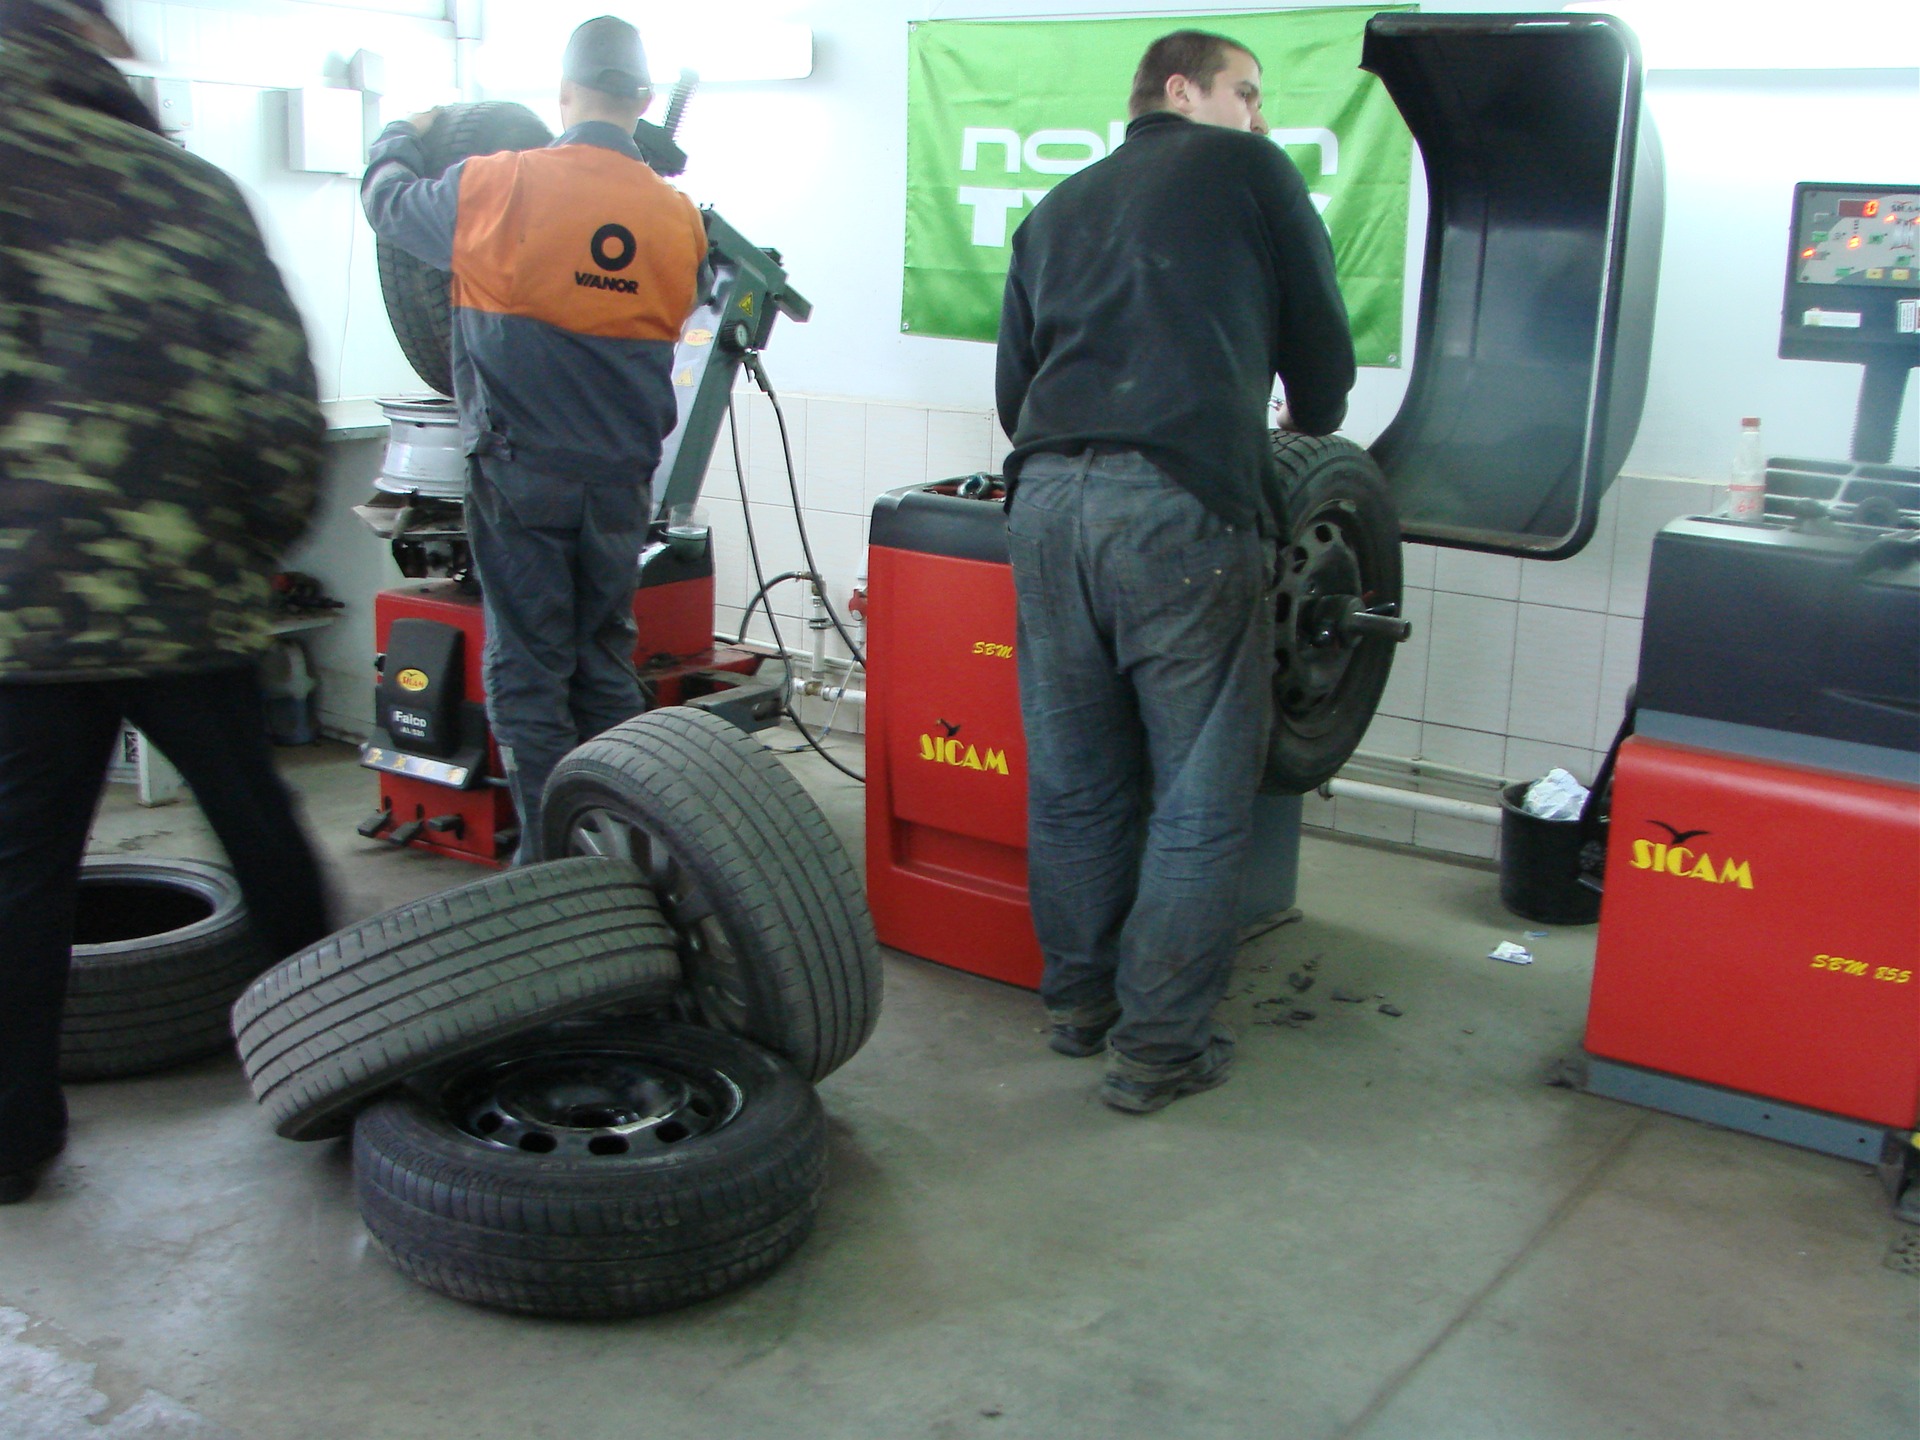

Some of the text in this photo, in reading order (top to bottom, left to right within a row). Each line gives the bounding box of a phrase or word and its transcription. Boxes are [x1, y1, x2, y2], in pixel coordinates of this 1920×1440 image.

[960, 121, 1339, 176] non
[574, 270, 639, 295] VIANOR
[972, 641, 1013, 659] SBM
[394, 710, 427, 728] Falco
[919, 733, 1009, 775] SICAM
[1629, 838, 1754, 890] SICAM
[1809, 954, 1912, 983] SBM 855
